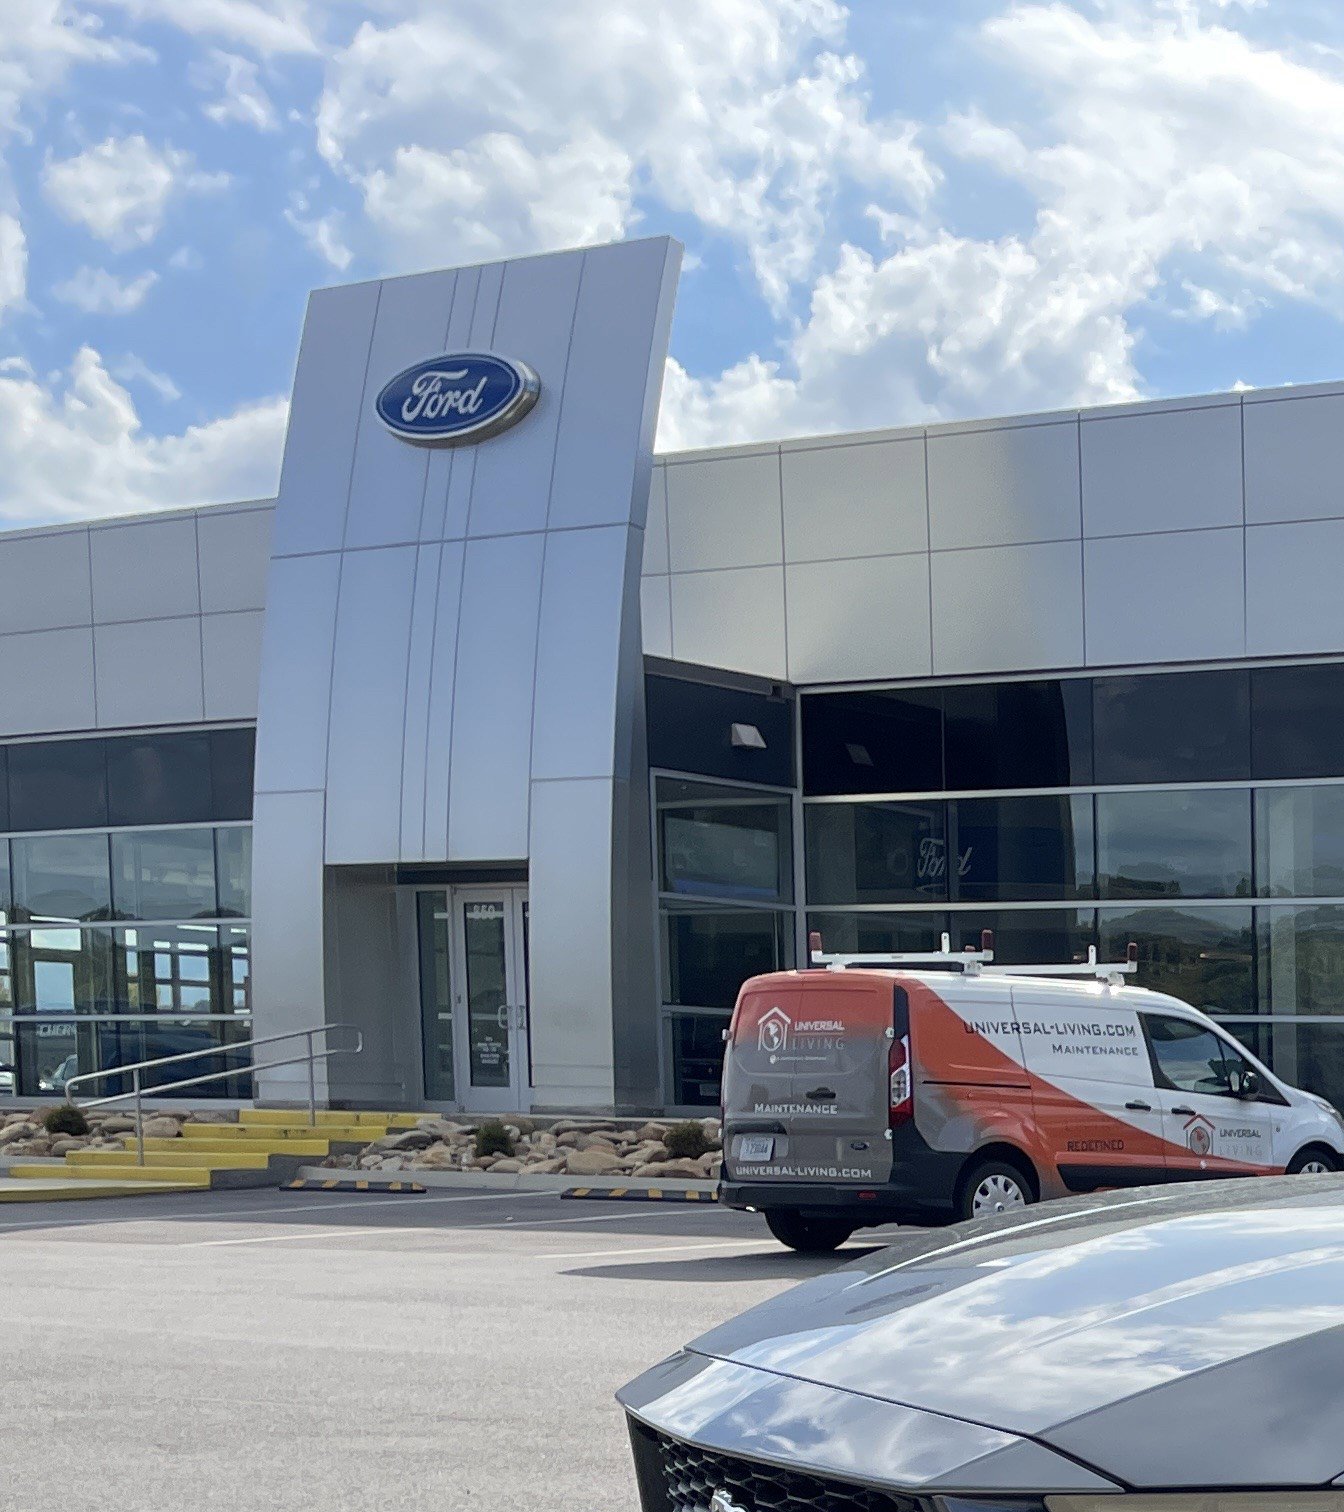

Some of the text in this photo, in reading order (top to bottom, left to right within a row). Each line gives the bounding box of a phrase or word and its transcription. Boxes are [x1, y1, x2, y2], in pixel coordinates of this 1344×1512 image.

[401, 368, 488, 422] Ford
[794, 1020, 845, 1032] UNIVERSAL
[963, 1021, 1137, 1038] UNIVERSAL-LIVING.COM
[792, 1036, 845, 1050] LIVING
[1219, 1129, 1262, 1139] UNIVERSAL
[736, 1165, 872, 1179] UNIVERSAL-LIVING.COM
